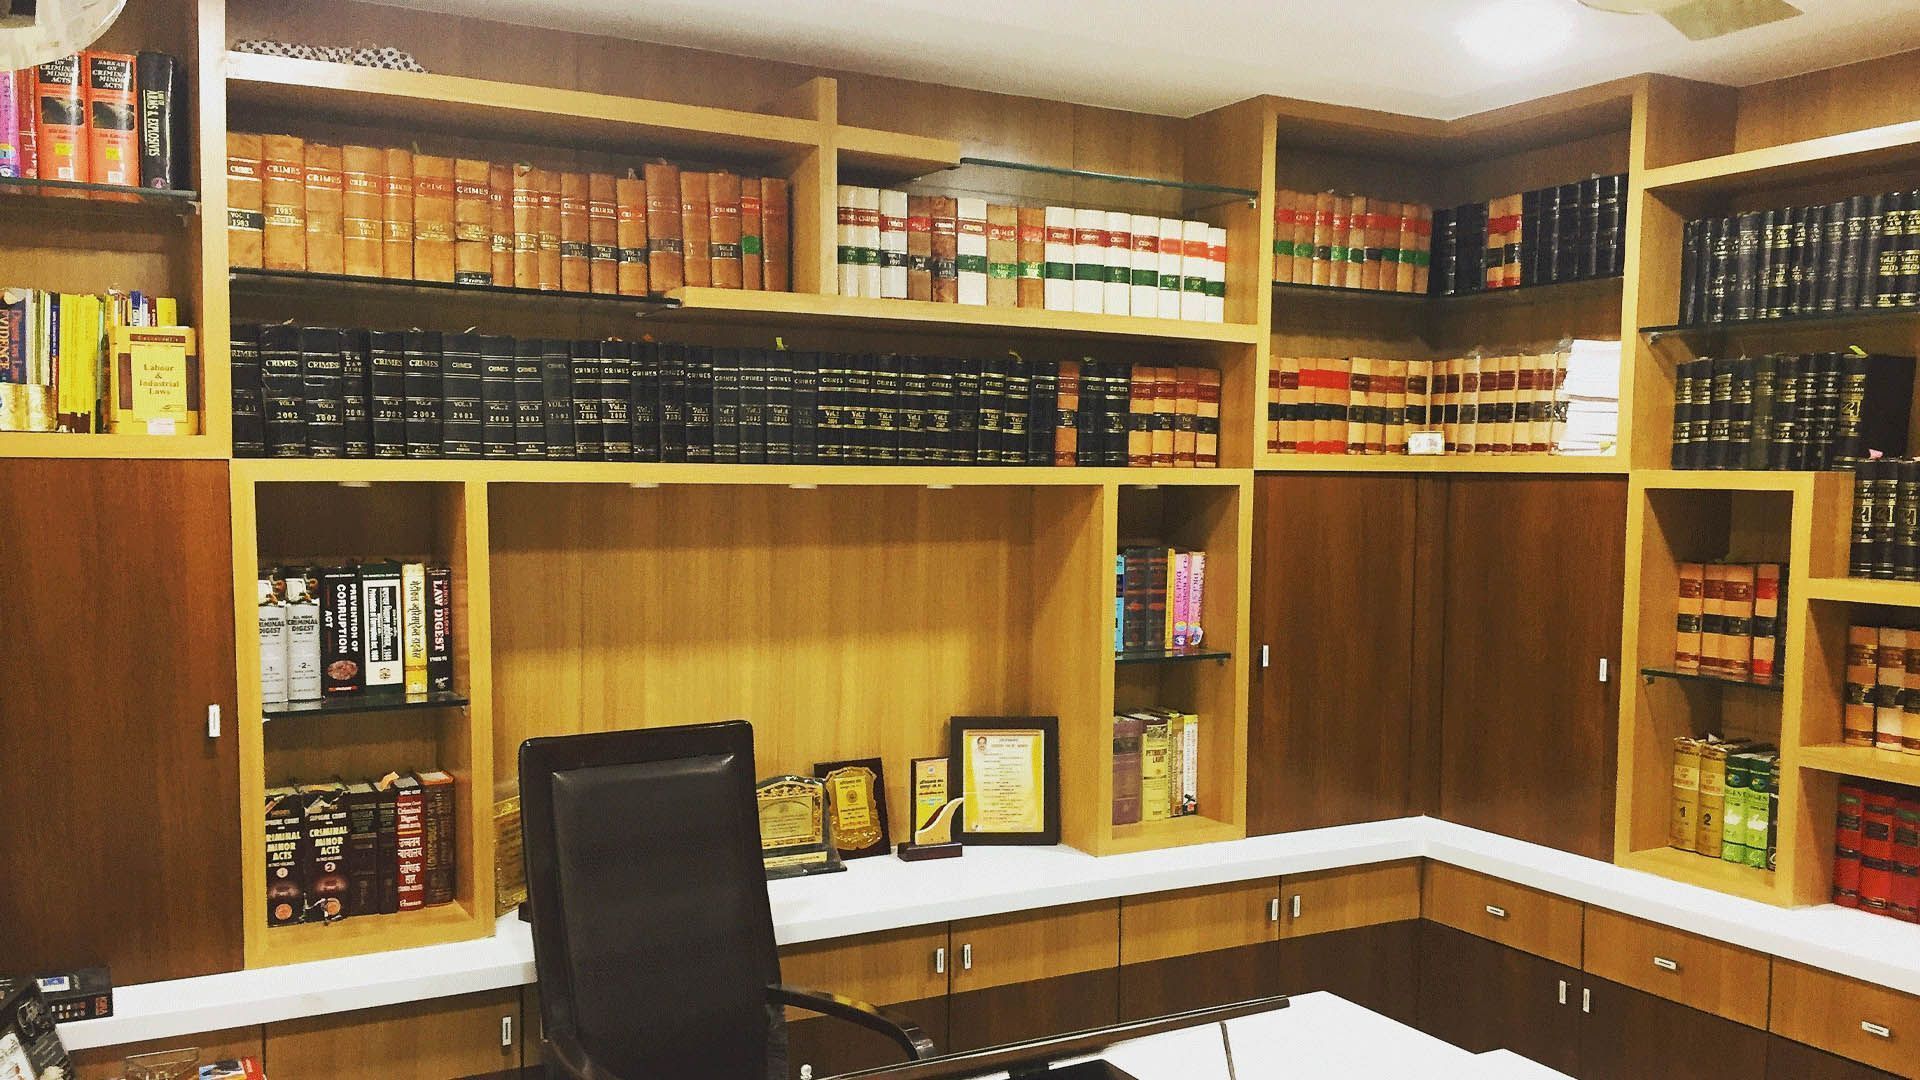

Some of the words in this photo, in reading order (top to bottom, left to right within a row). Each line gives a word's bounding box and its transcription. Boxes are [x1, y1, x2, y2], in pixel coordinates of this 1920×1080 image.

[40, 64, 79, 73] CRIMIN
[147, 90, 159, 109] ARMS
[147, 118, 160, 157] EXPLOSIVES
[266, 164, 301, 175] CRIMES
[306, 173, 342, 184] CRIMES
[456, 186, 489, 195] CRIMES
[231, 349, 258, 358] RIMES
[144, 363, 175, 372] Labour
[265, 359, 298, 368] CRIMES
[308, 361, 340, 369] CRIMES
[373, 358, 403, 367] CRIMES
[409, 359, 439, 368] CRIMES
[604, 367, 630, 375] CRIMES
[139, 379, 180, 388] Industrial
[149, 387, 171, 395] Laws
[316, 414, 337, 422] 2002
[413, 410, 436, 418] 2002
[433, 579, 444, 607] LAW
[350, 583, 359, 639] PREVENTION
[324, 610, 334, 629] ACT
[336, 583, 348, 654] CORRUPTION
[434, 608, 445, 652] DIGEST
[350, 640, 359, 653] OF
[1680, 806, 1687, 818] 1
[1703, 813, 1712, 826] 2
[266, 831, 301, 842] RIMINAL
[309, 825, 349, 838] CRIMINAL
[315, 836, 344, 847] MINOR
[267, 842, 296, 853] MINOR
[320, 846, 340, 855] ACTS
[272, 851, 293, 861] ACTS
